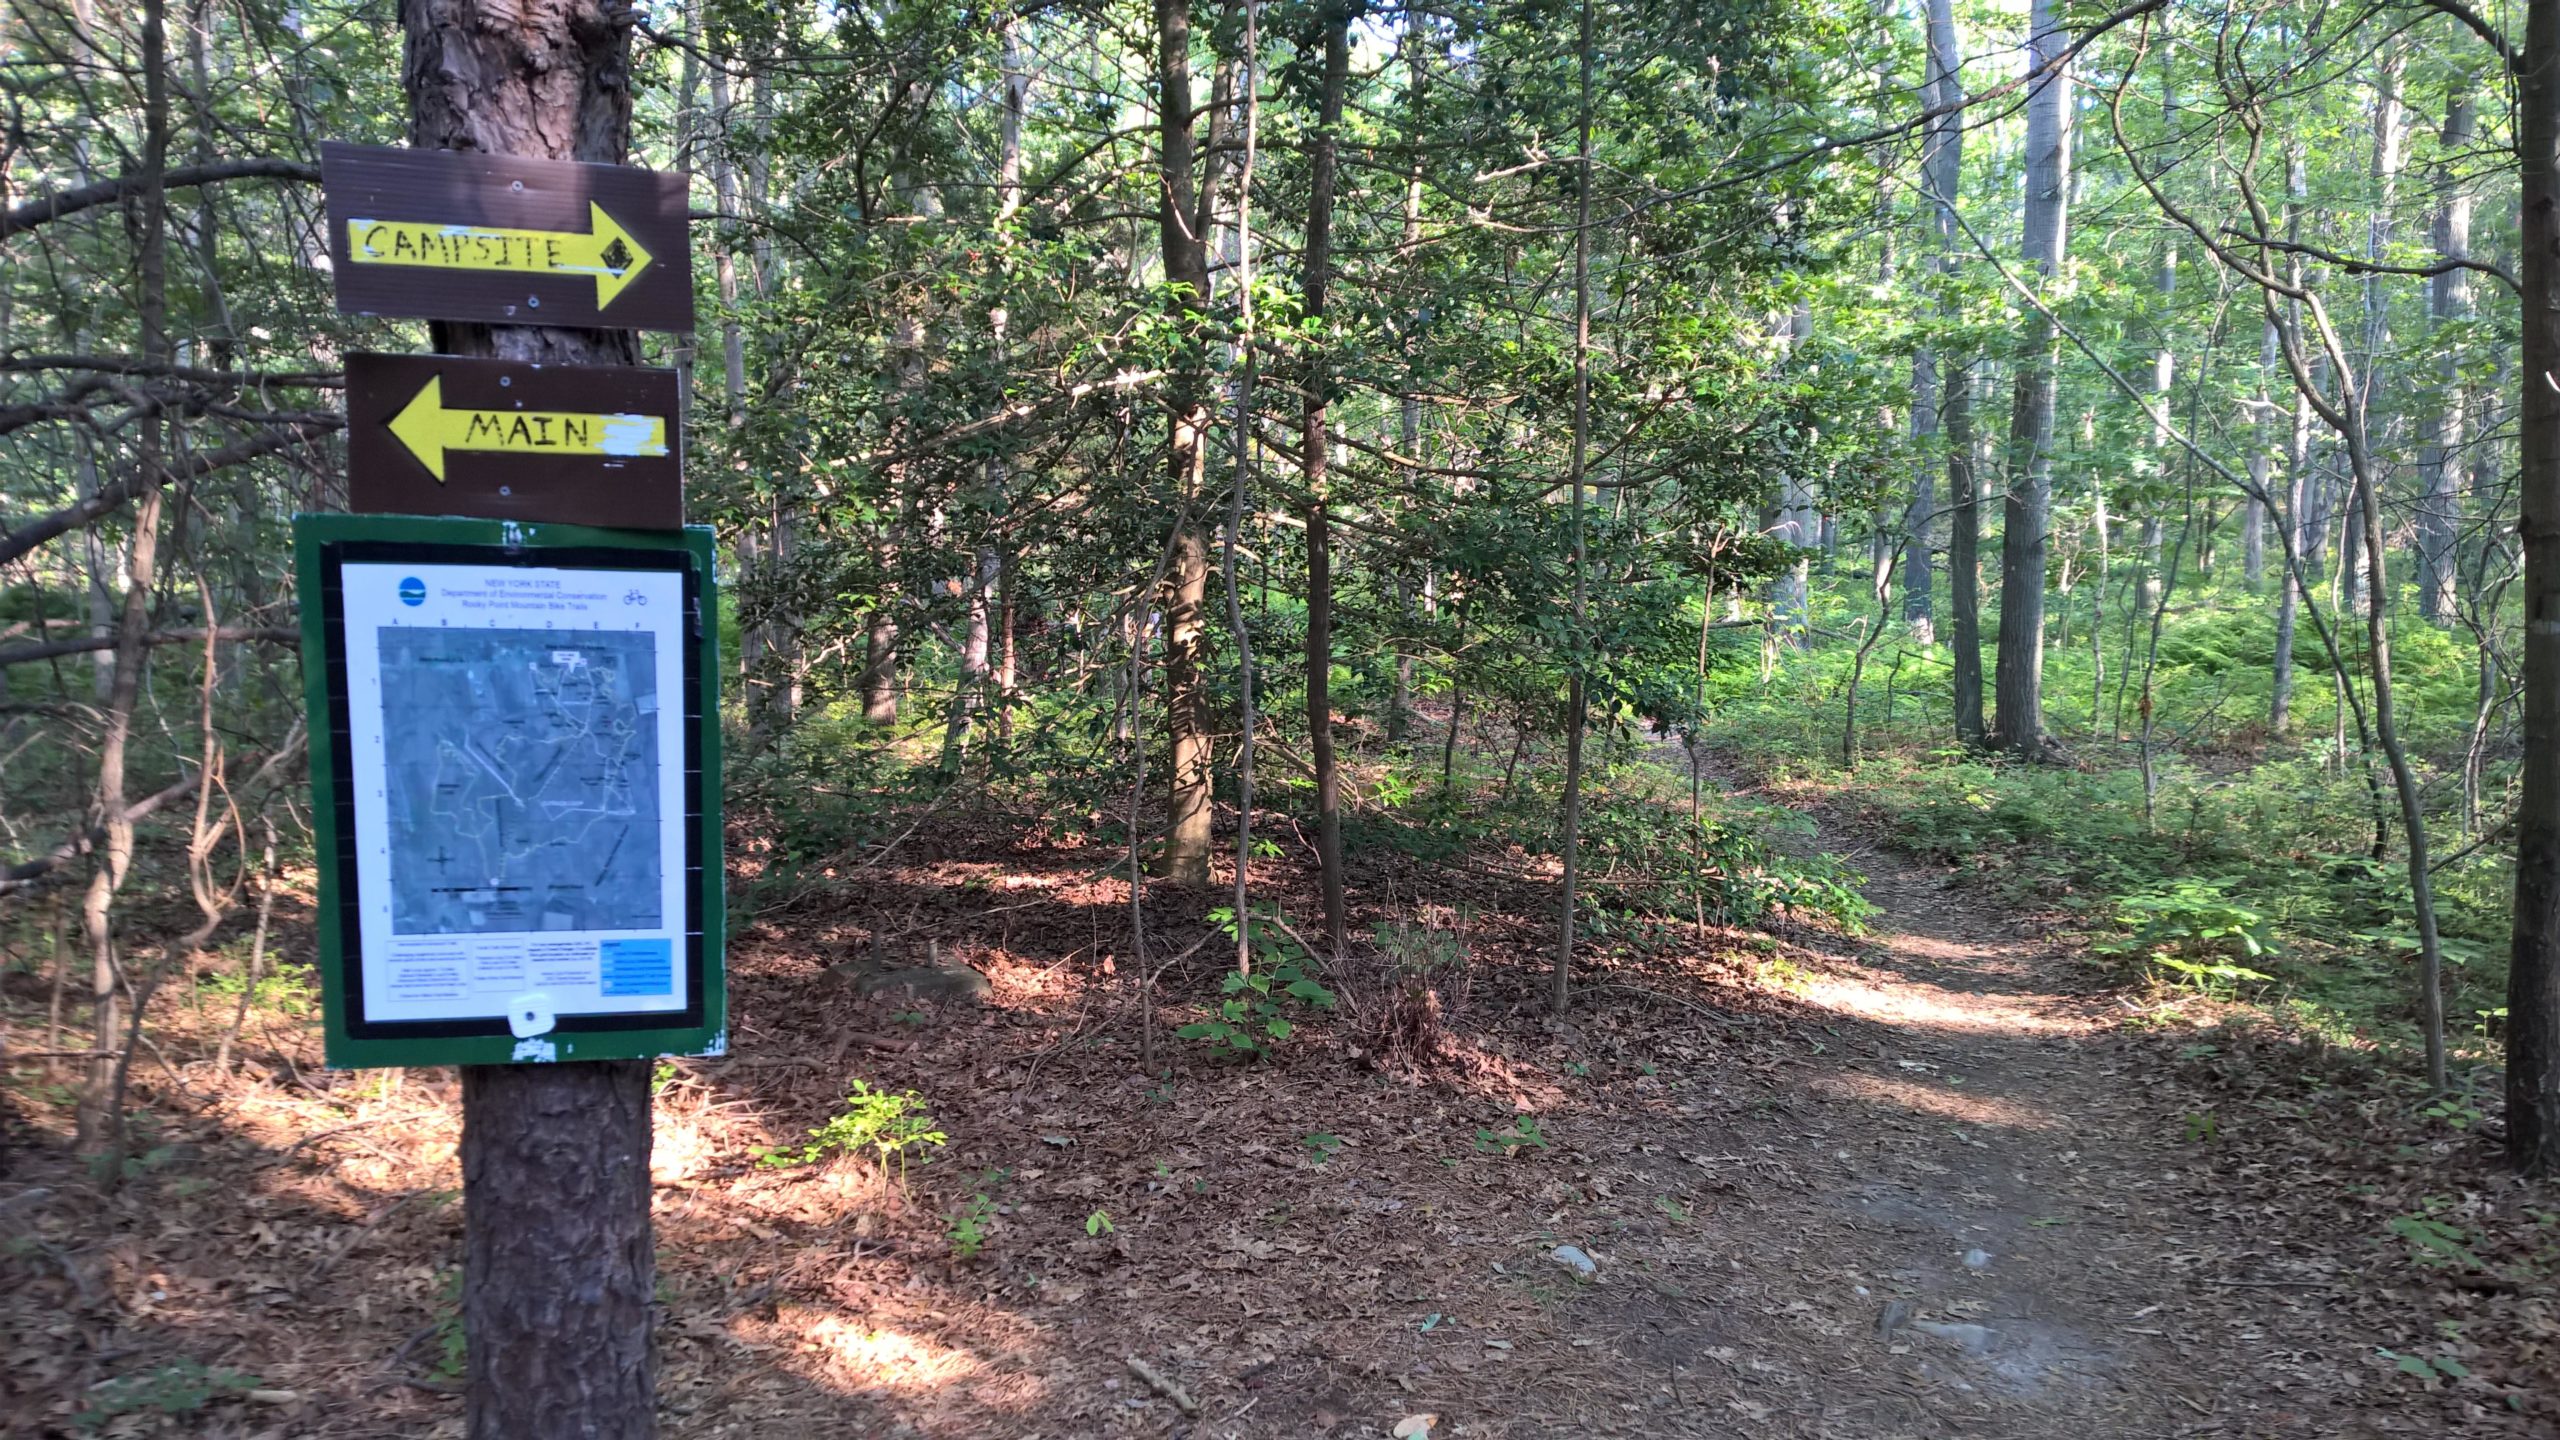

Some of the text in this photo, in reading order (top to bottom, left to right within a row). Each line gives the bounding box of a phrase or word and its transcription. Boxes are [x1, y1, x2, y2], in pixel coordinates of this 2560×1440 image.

[366, 226, 564, 267] CAMPSITE
[465, 413, 587, 447] MAIN
[484, 579, 561, 589] NEW YORK STATE
[441, 588, 487, 599] Department
[499, 589, 554, 599] Environmental
[556, 591, 608, 600] Conservation
[462, 599, 486, 610] Rocky
[488, 600, 509, 609] Point
[510, 601, 546, 609] Mountain
